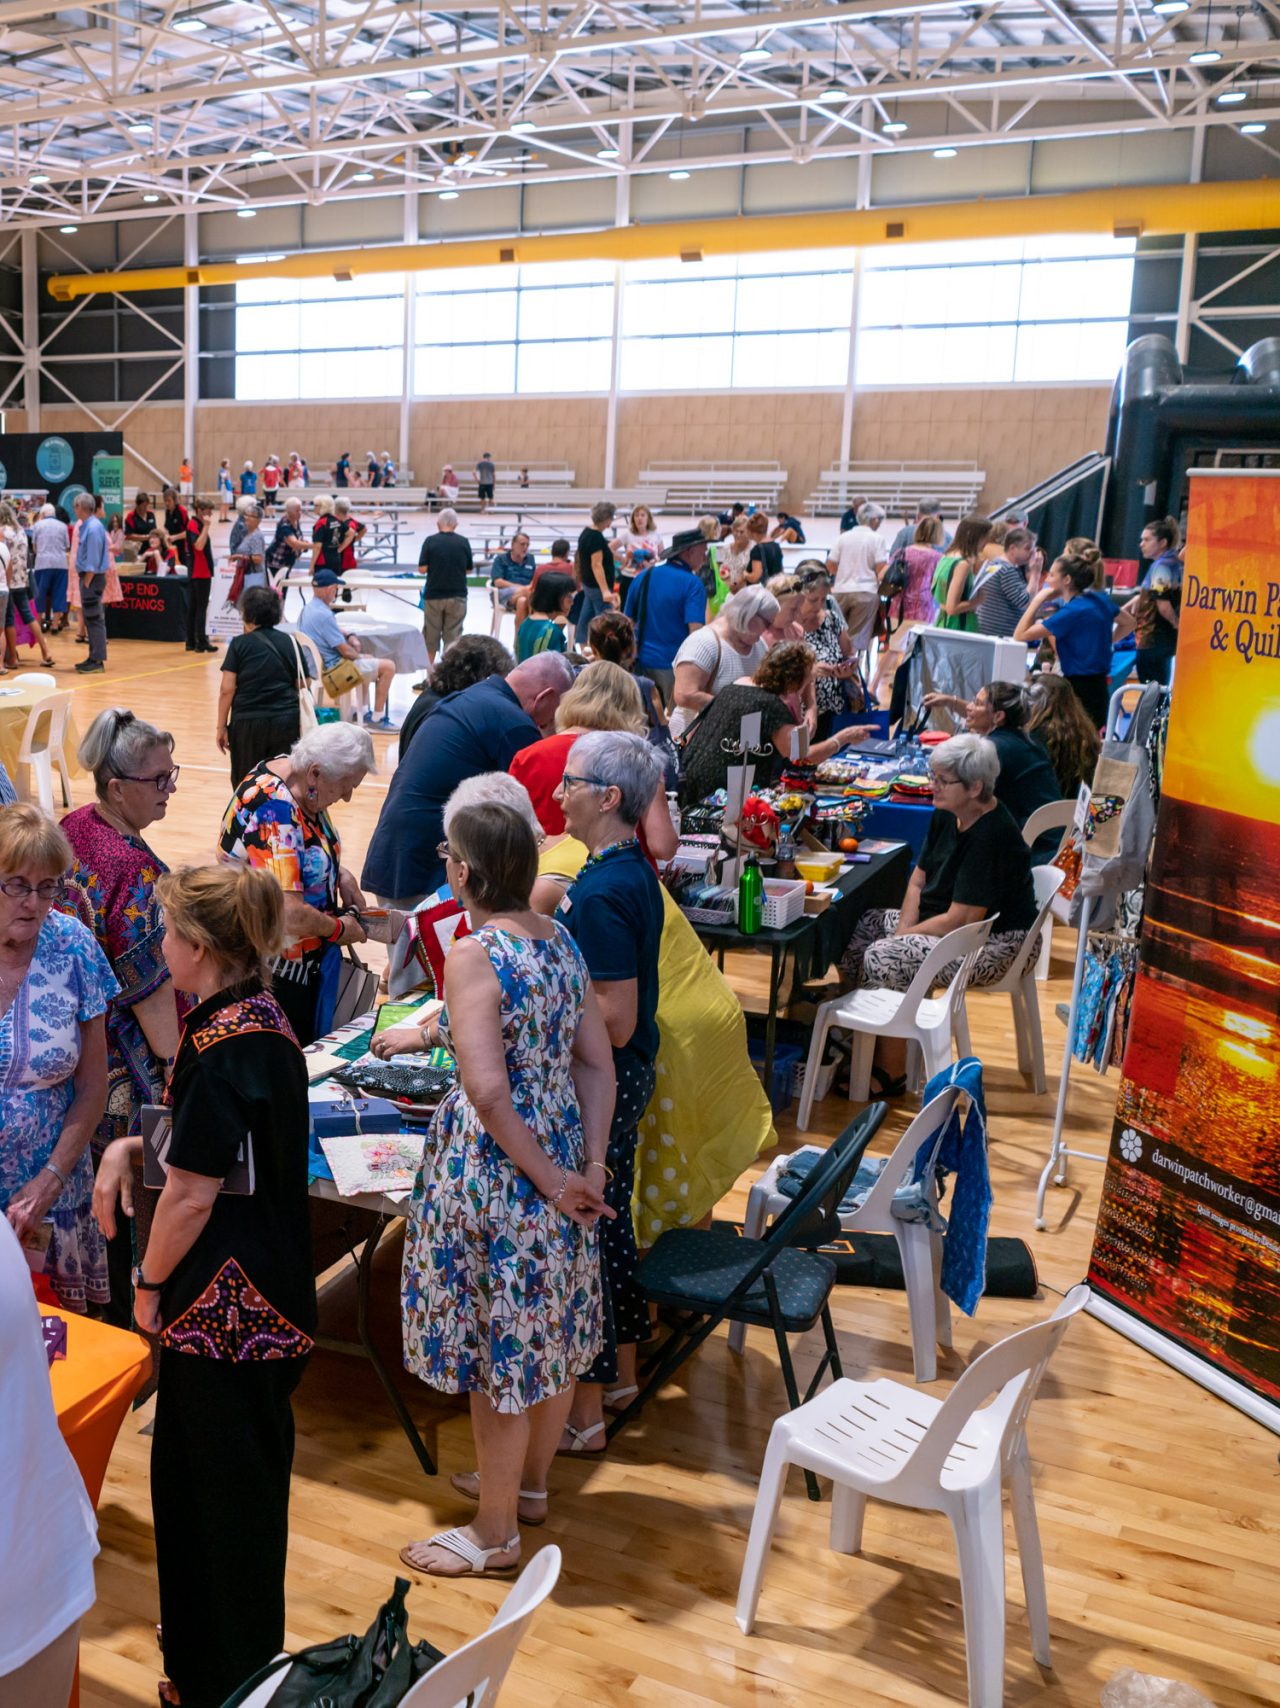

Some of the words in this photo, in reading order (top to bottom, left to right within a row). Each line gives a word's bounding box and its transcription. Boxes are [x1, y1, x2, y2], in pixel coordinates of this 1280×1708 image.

[137, 583, 160, 596] END
[1186, 575, 1257, 615] Darwin
[106, 598, 165, 612] USTANGS
[1210, 619, 1229, 652] &
